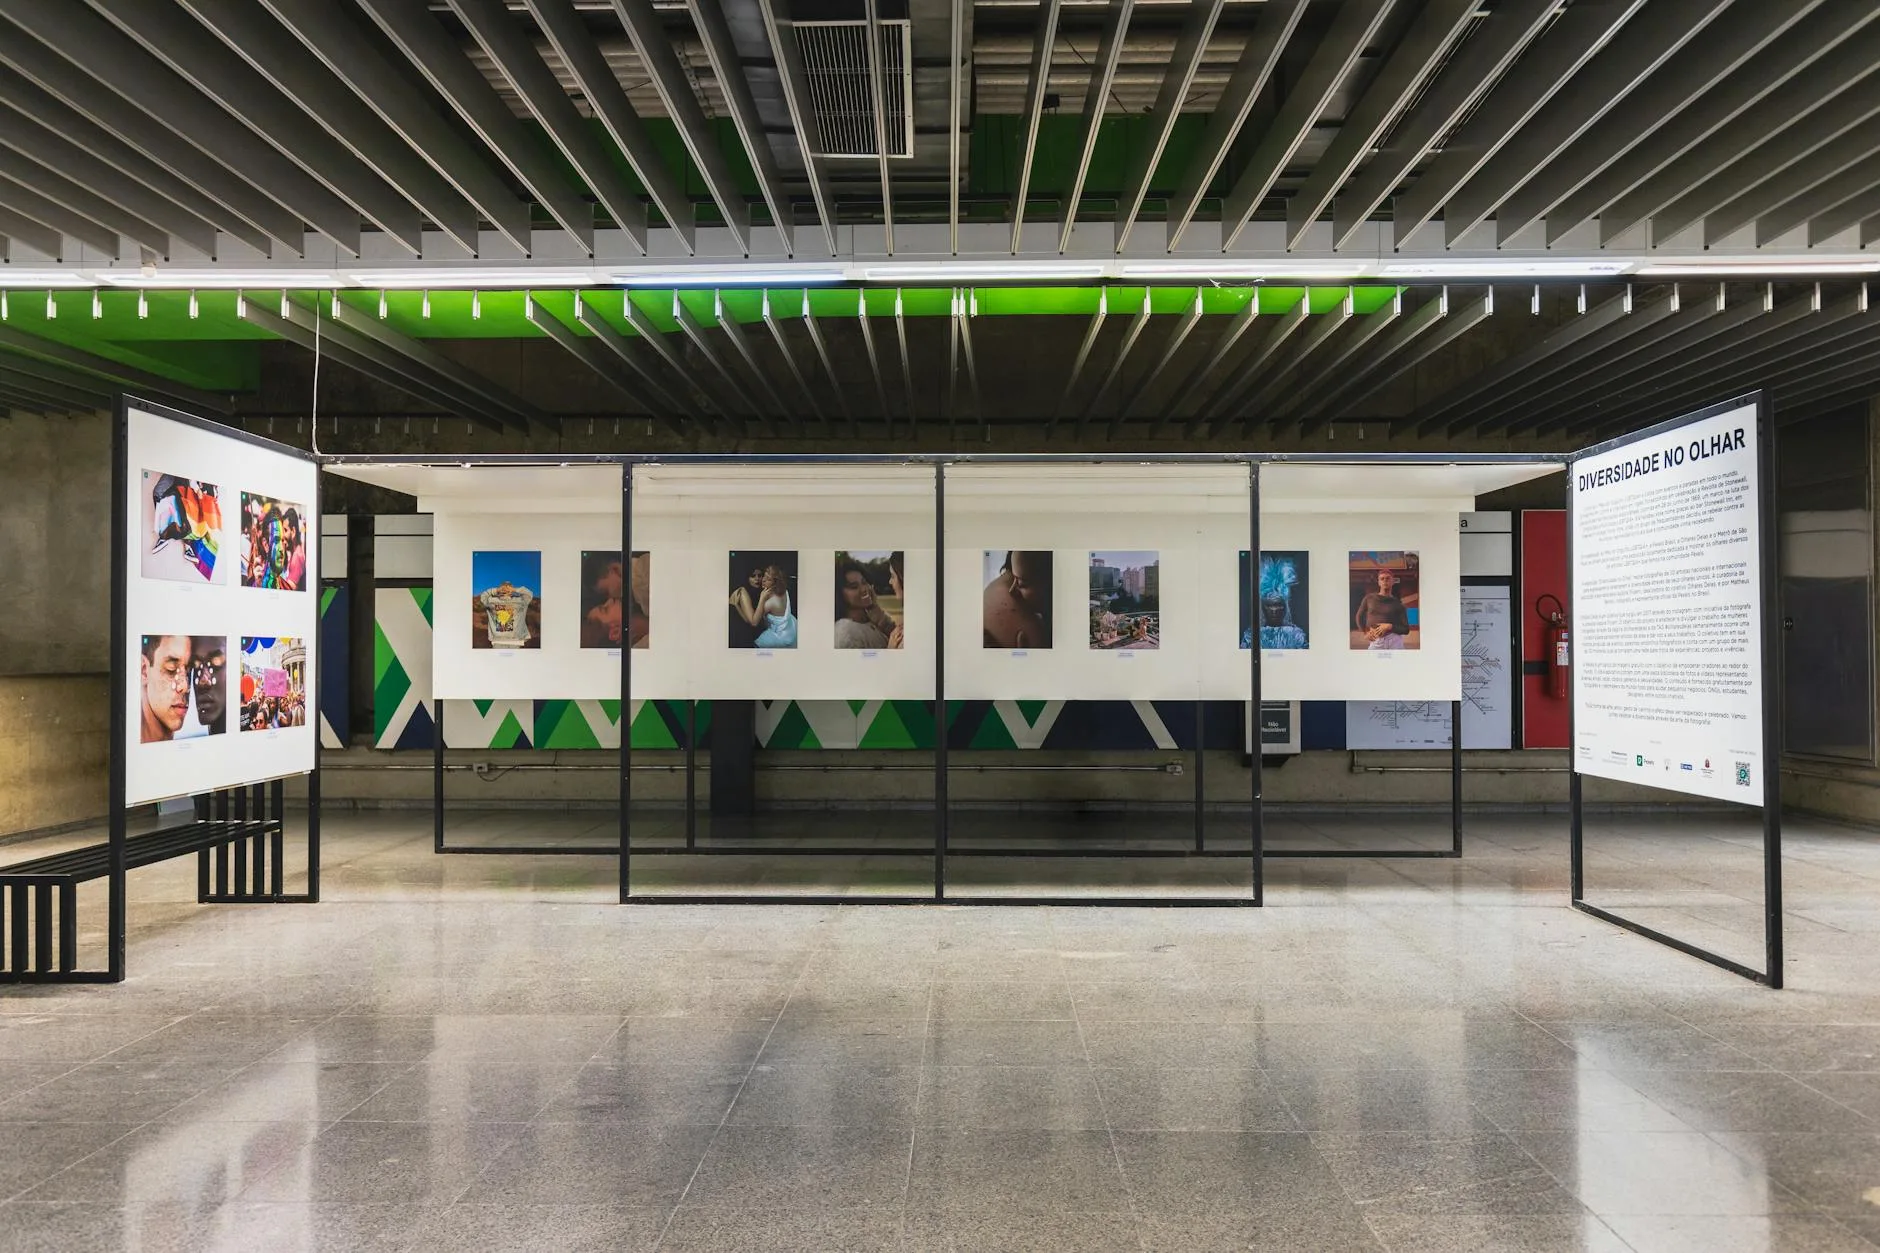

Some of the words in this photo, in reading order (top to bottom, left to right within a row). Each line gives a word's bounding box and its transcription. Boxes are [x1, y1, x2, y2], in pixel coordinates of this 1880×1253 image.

[1579, 453, 1660, 492] DIVERSIDADE
[1664, 446, 1684, 468] NO
[1689, 428, 1746, 461] OLHAR
